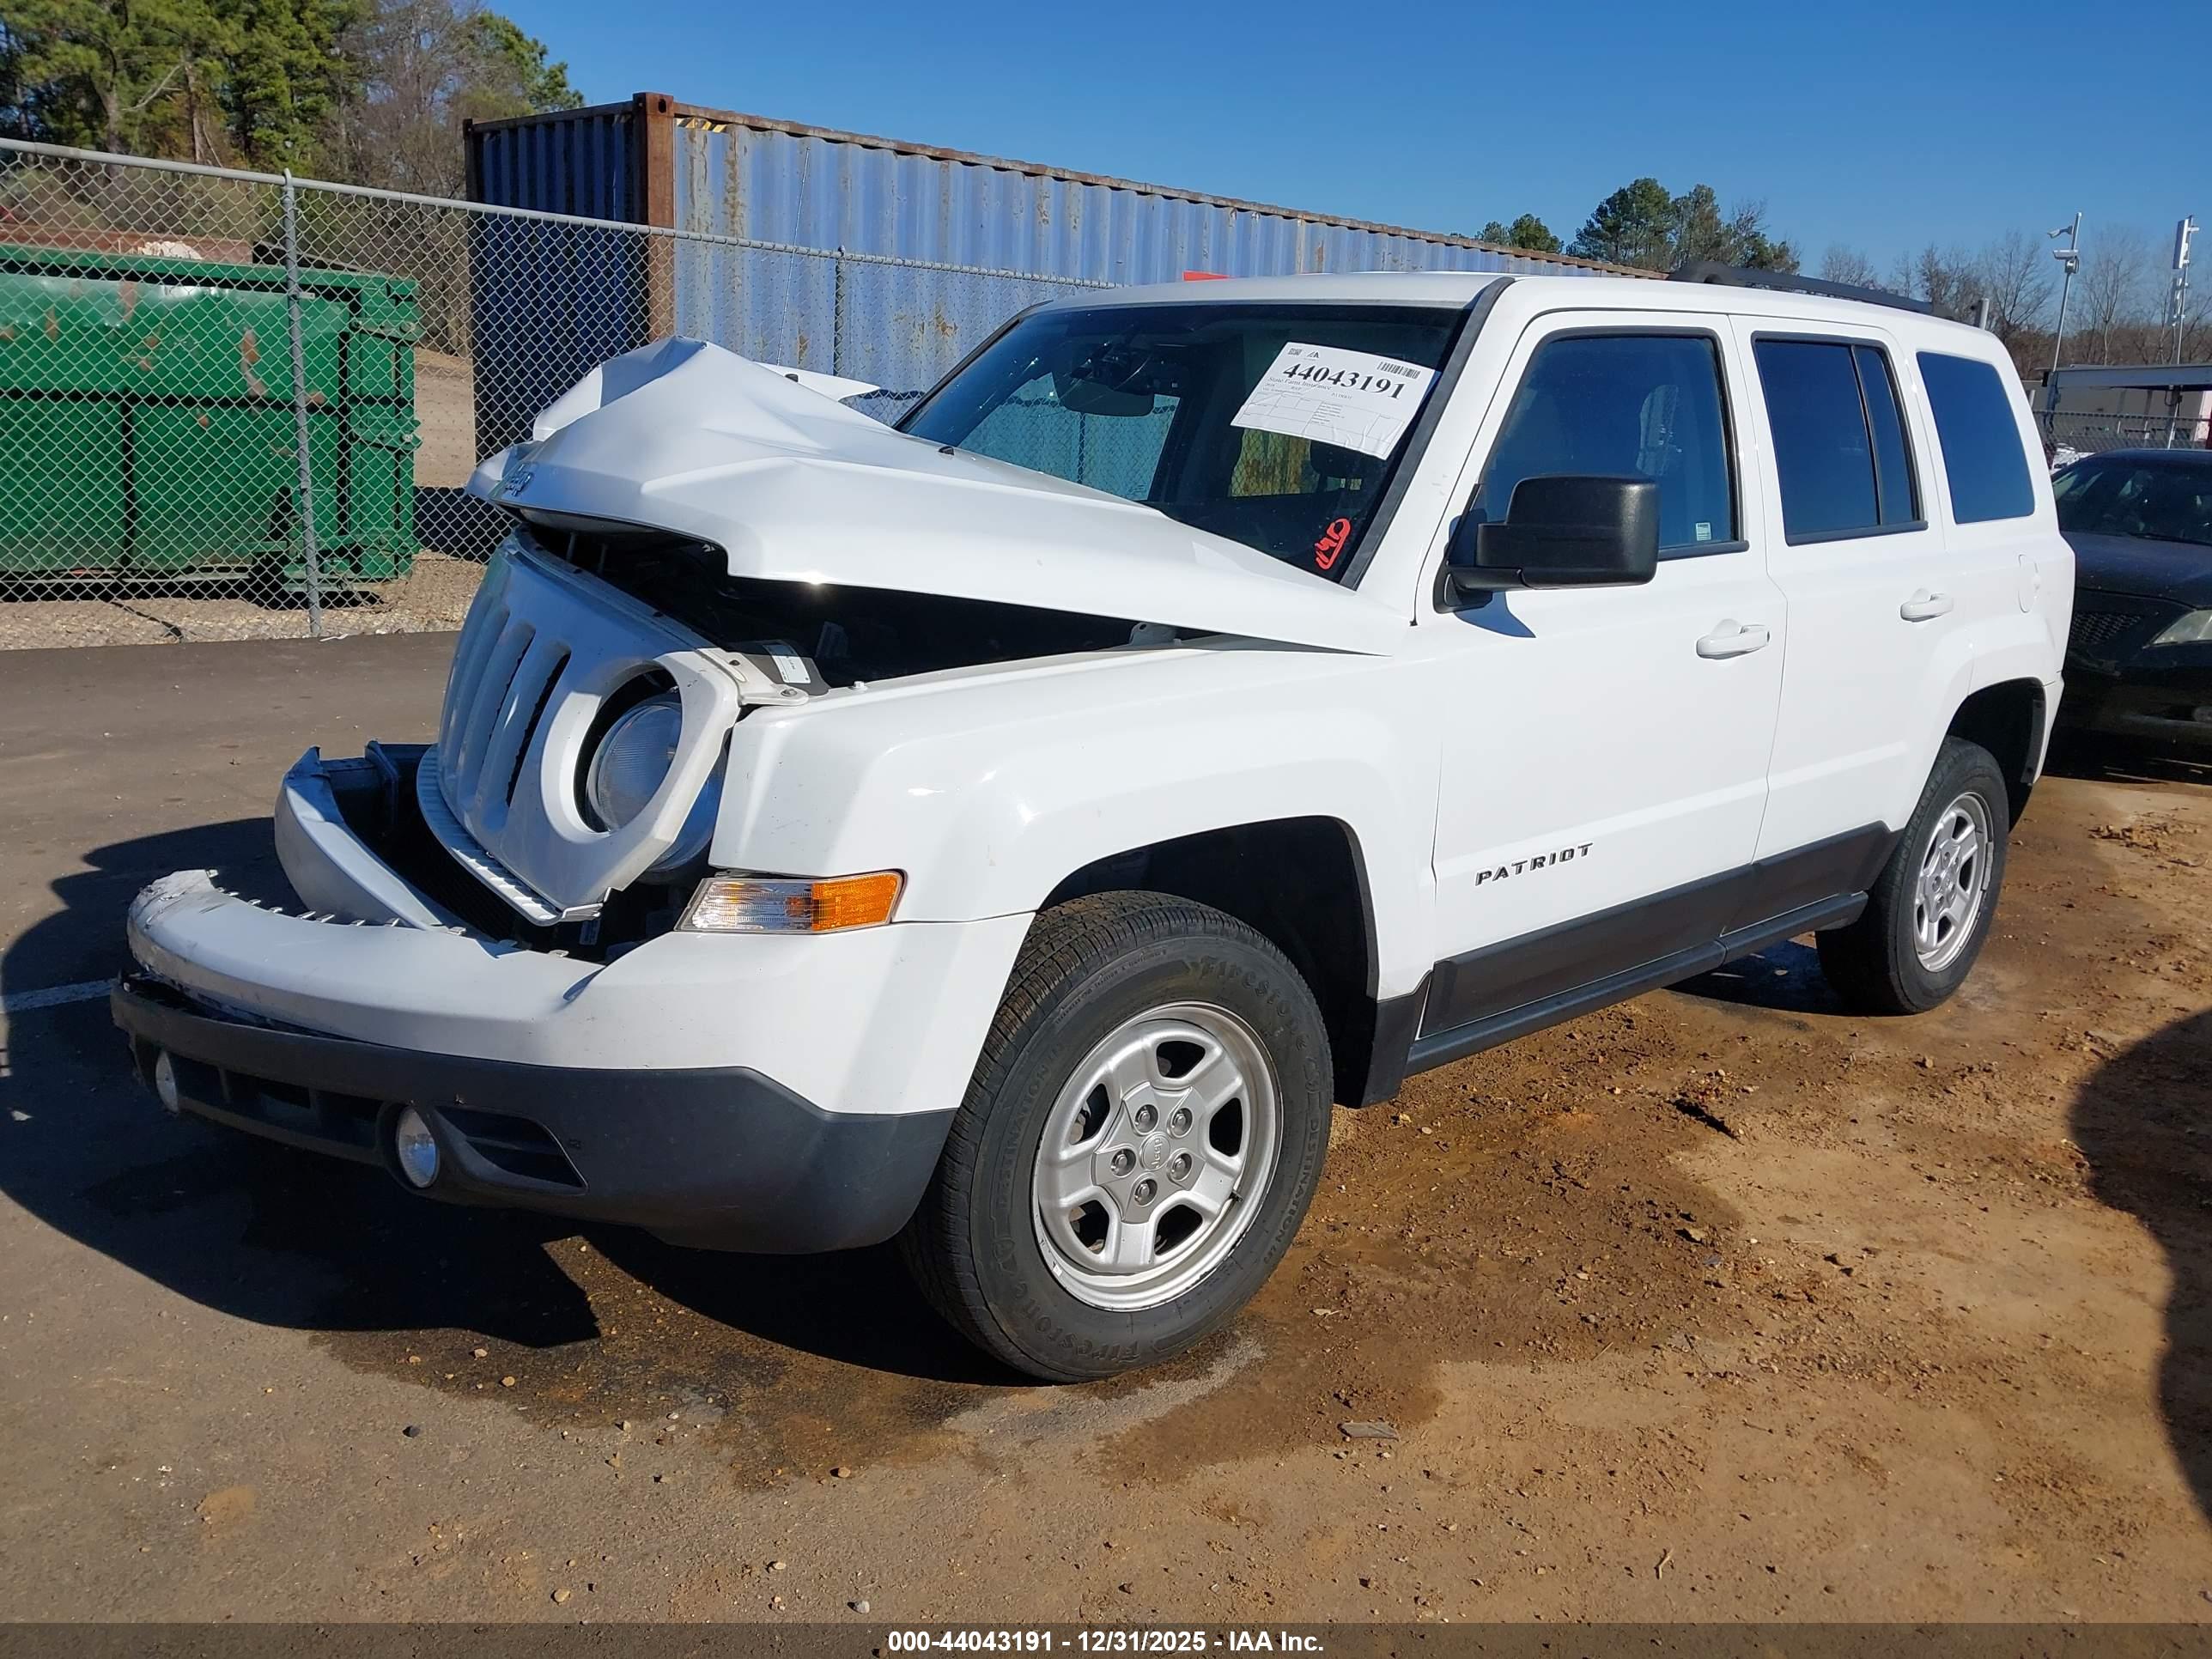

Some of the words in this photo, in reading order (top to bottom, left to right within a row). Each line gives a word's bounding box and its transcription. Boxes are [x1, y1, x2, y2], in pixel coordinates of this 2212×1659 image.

[1283, 363, 1406, 399] 44043191
[1284, 378, 1301, 386] Farm
[1474, 842, 1594, 887] PATRIOT
[1151, 1138, 1163, 1169] Jeep
[1275, 1117, 1321, 1245] DESTINATION
